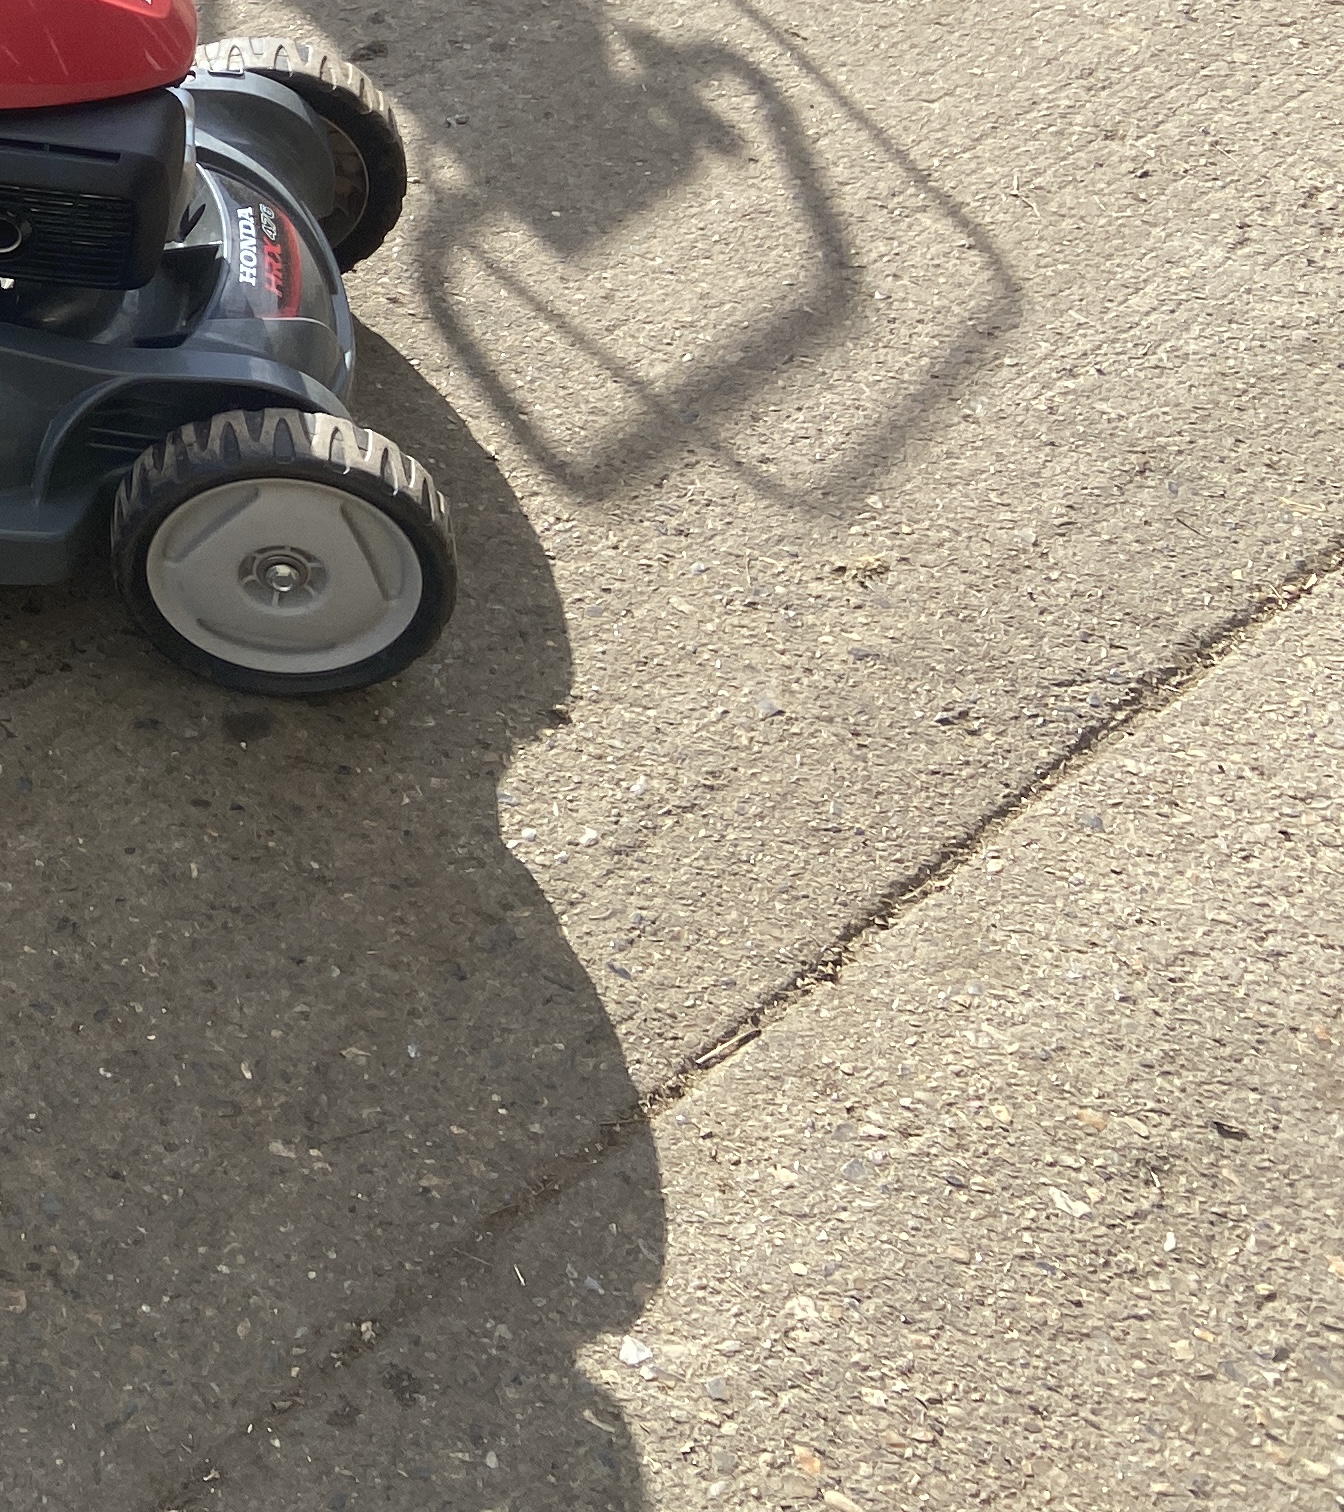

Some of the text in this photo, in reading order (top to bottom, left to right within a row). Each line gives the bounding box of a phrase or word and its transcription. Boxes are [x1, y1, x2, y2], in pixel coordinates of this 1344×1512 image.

[237, 206, 257, 287] HONDA
[259, 203, 283, 299] HRX 476
